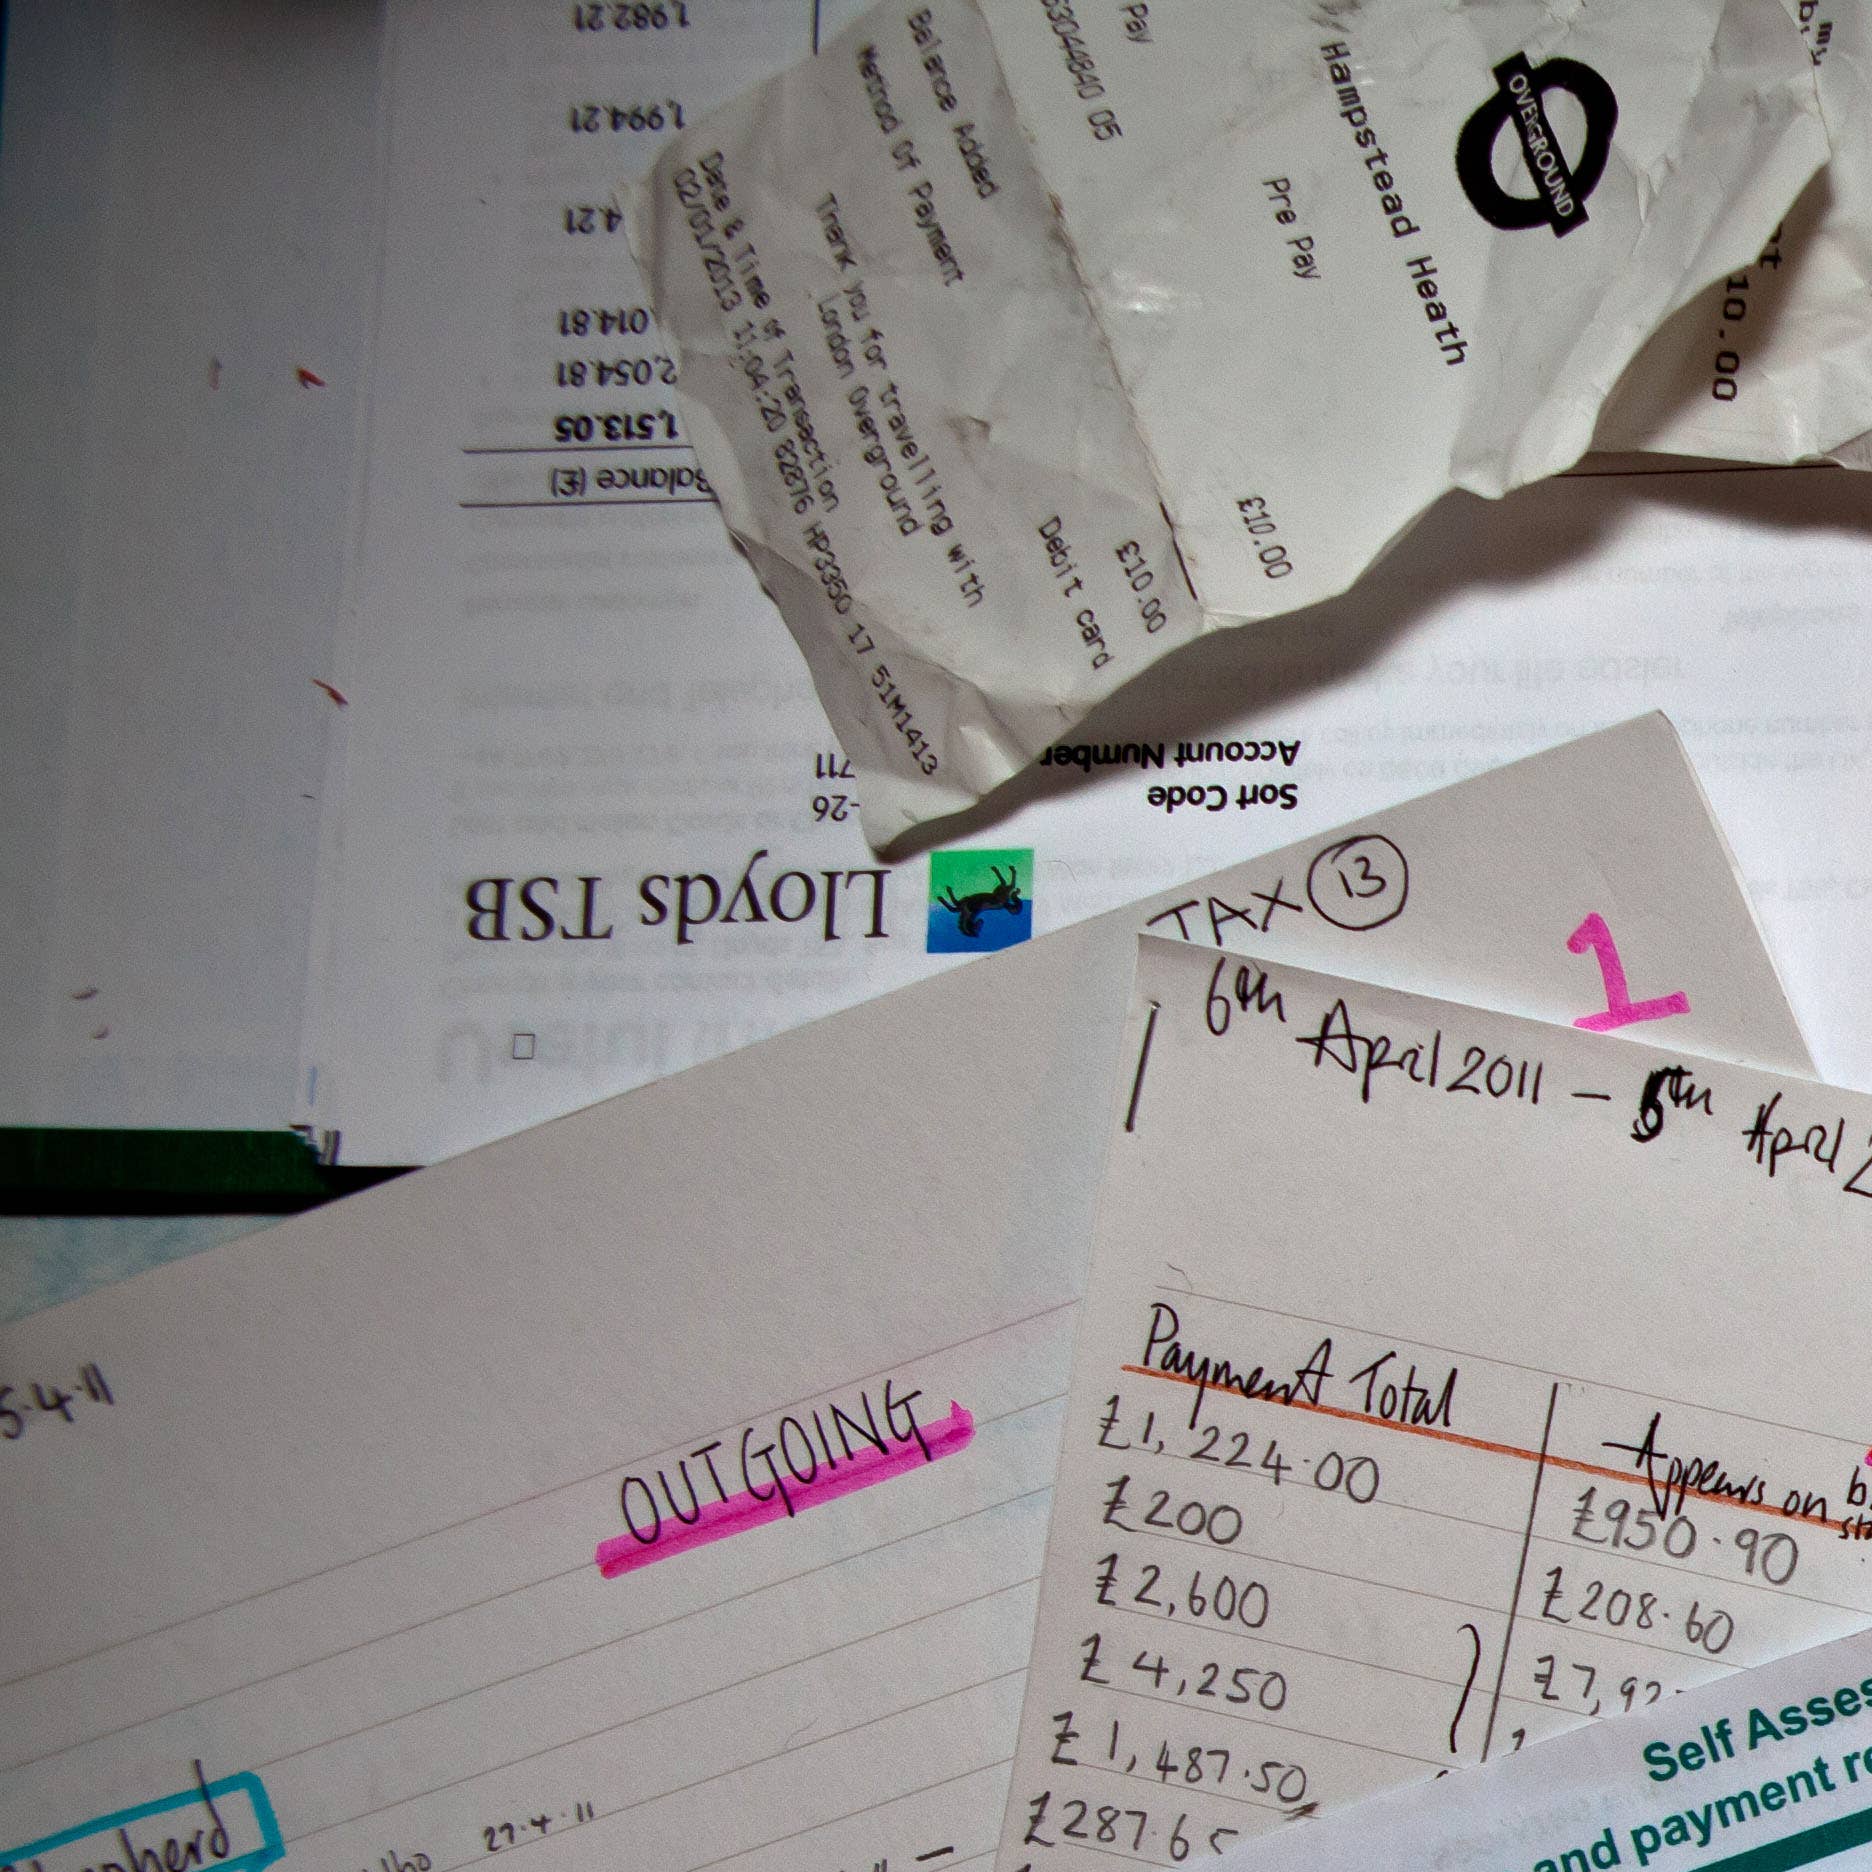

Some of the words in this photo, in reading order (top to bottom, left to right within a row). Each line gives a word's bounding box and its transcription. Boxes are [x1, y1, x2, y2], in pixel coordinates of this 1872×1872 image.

[568, 100, 684, 132] 1,994.21
[1505, 70, 1577, 220] OVERGROUND
[1262, 176, 1297, 225] Pre
[1286, 235, 1320, 279] Pay
[1319, 41, 1420, 238] Hampstead
[1405, 255, 1467, 365] Heath
[554, 410, 678, 442] 1,513.05
[1235, 495, 1293, 579] £10.00
[1037, 514, 1082, 597] Debit
[1075, 608, 1112, 670] card
[1114, 539, 1167, 634] £10.00
[1038, 742, 1164, 772] Number
[1173, 738, 1303, 769] Account
[1146, 784, 1226, 812] Code
[1236, 784, 1296, 810] Sort
[465, 876, 612, 940] TSB
[639, 849, 890, 944] Lloyds
[1145, 877, 1303, 946] TAX
[1338, 855, 1386, 898] 13
[1565, 912, 1690, 1029] 1
[1445, 1045, 1542, 1104] 2011
[1348, 1350, 1457, 1438] Total
[619, 1379, 929, 1547] OUTGOING
[1102, 1474, 1242, 1545] £200
[1095, 1552, 1269, 1628] £2,600
[1541, 1565, 1734, 1654] £208.60
[1643, 1718, 1734, 1781] Self
[1630, 1756, 1836, 1866] payment
